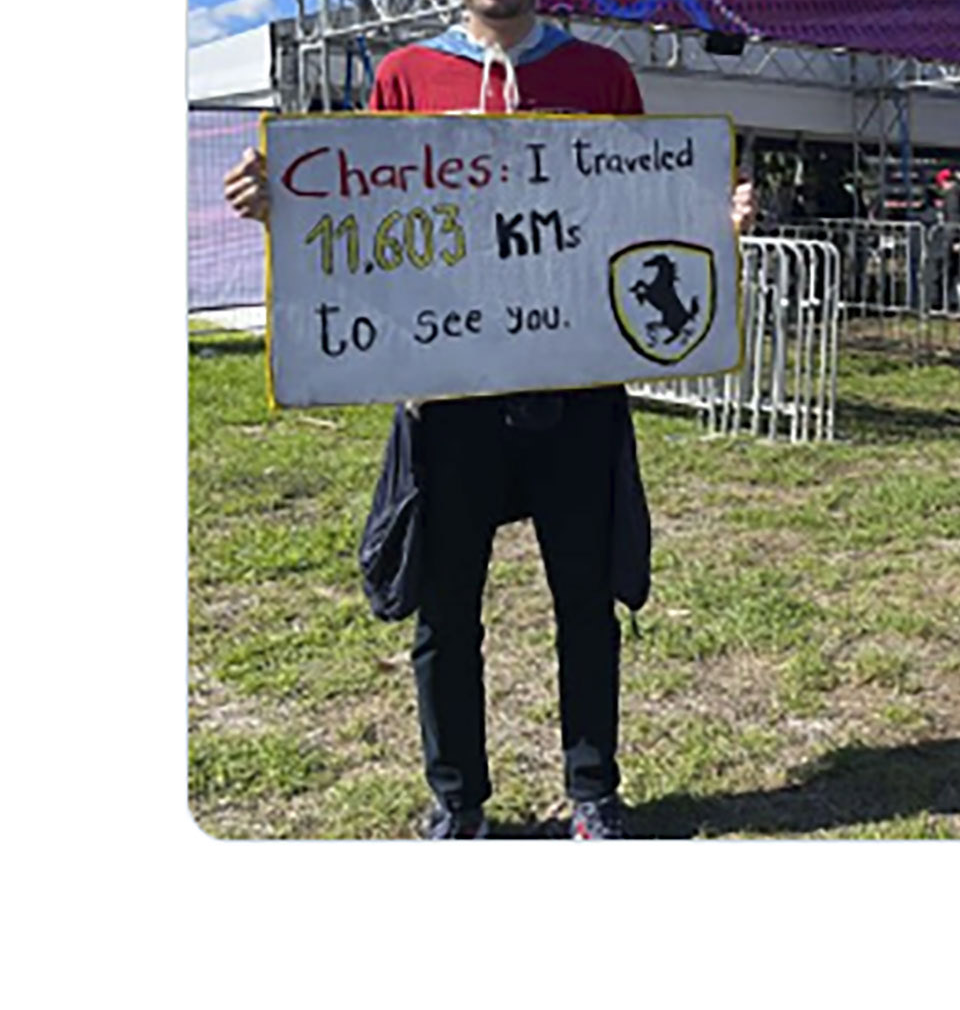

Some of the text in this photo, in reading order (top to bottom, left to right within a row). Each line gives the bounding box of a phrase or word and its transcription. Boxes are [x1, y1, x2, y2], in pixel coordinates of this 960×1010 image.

[281, 137, 695, 199] Charles: I traveled
[304, 202, 583, 277] 11.603 KMs
[315, 302, 572, 358] to see you.
